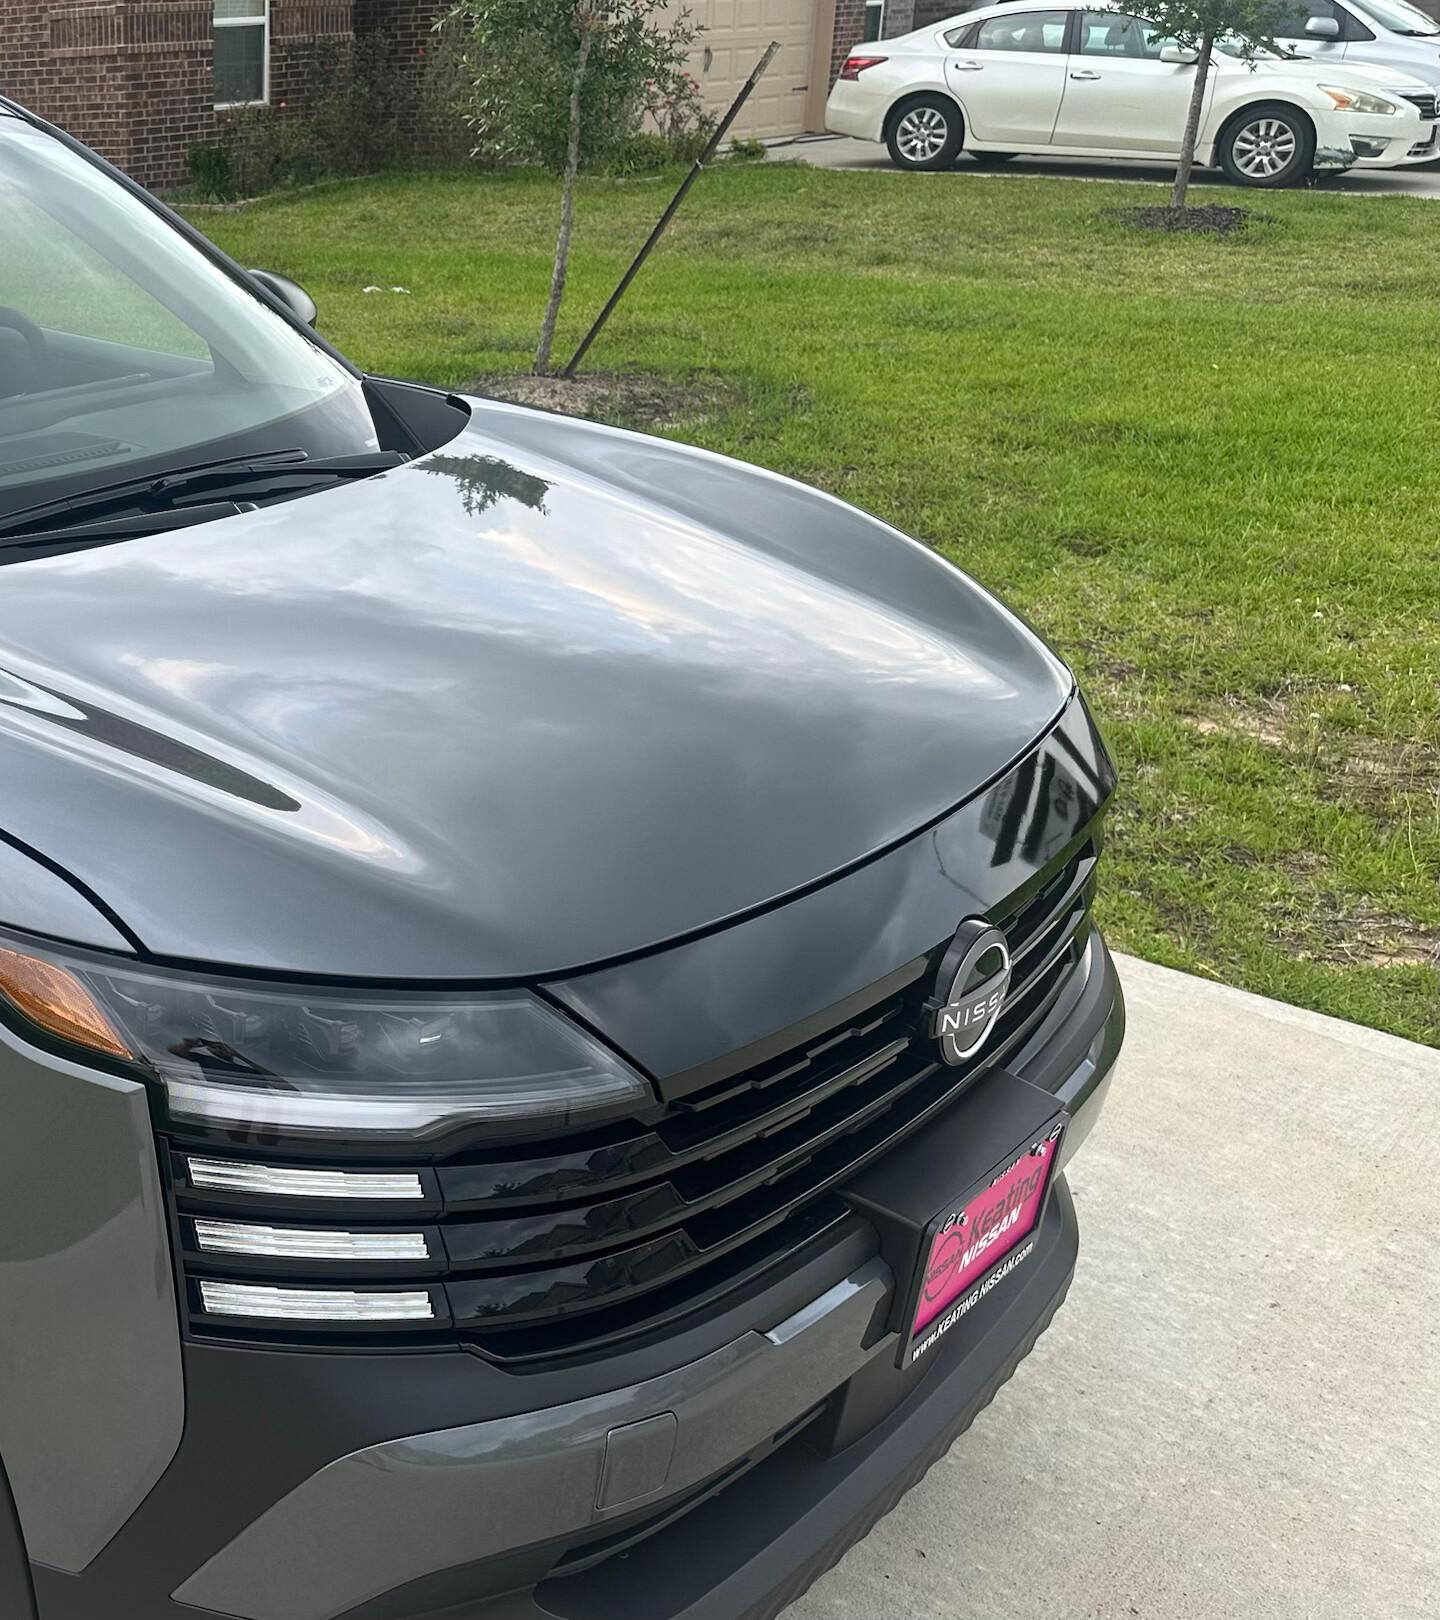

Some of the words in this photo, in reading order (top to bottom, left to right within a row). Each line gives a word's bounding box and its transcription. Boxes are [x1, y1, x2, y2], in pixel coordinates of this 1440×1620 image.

[941, 985, 1006, 1033] NISS
[958, 1203, 1022, 1273] NISSAN
[966, 1165, 1041, 1247] Keating
